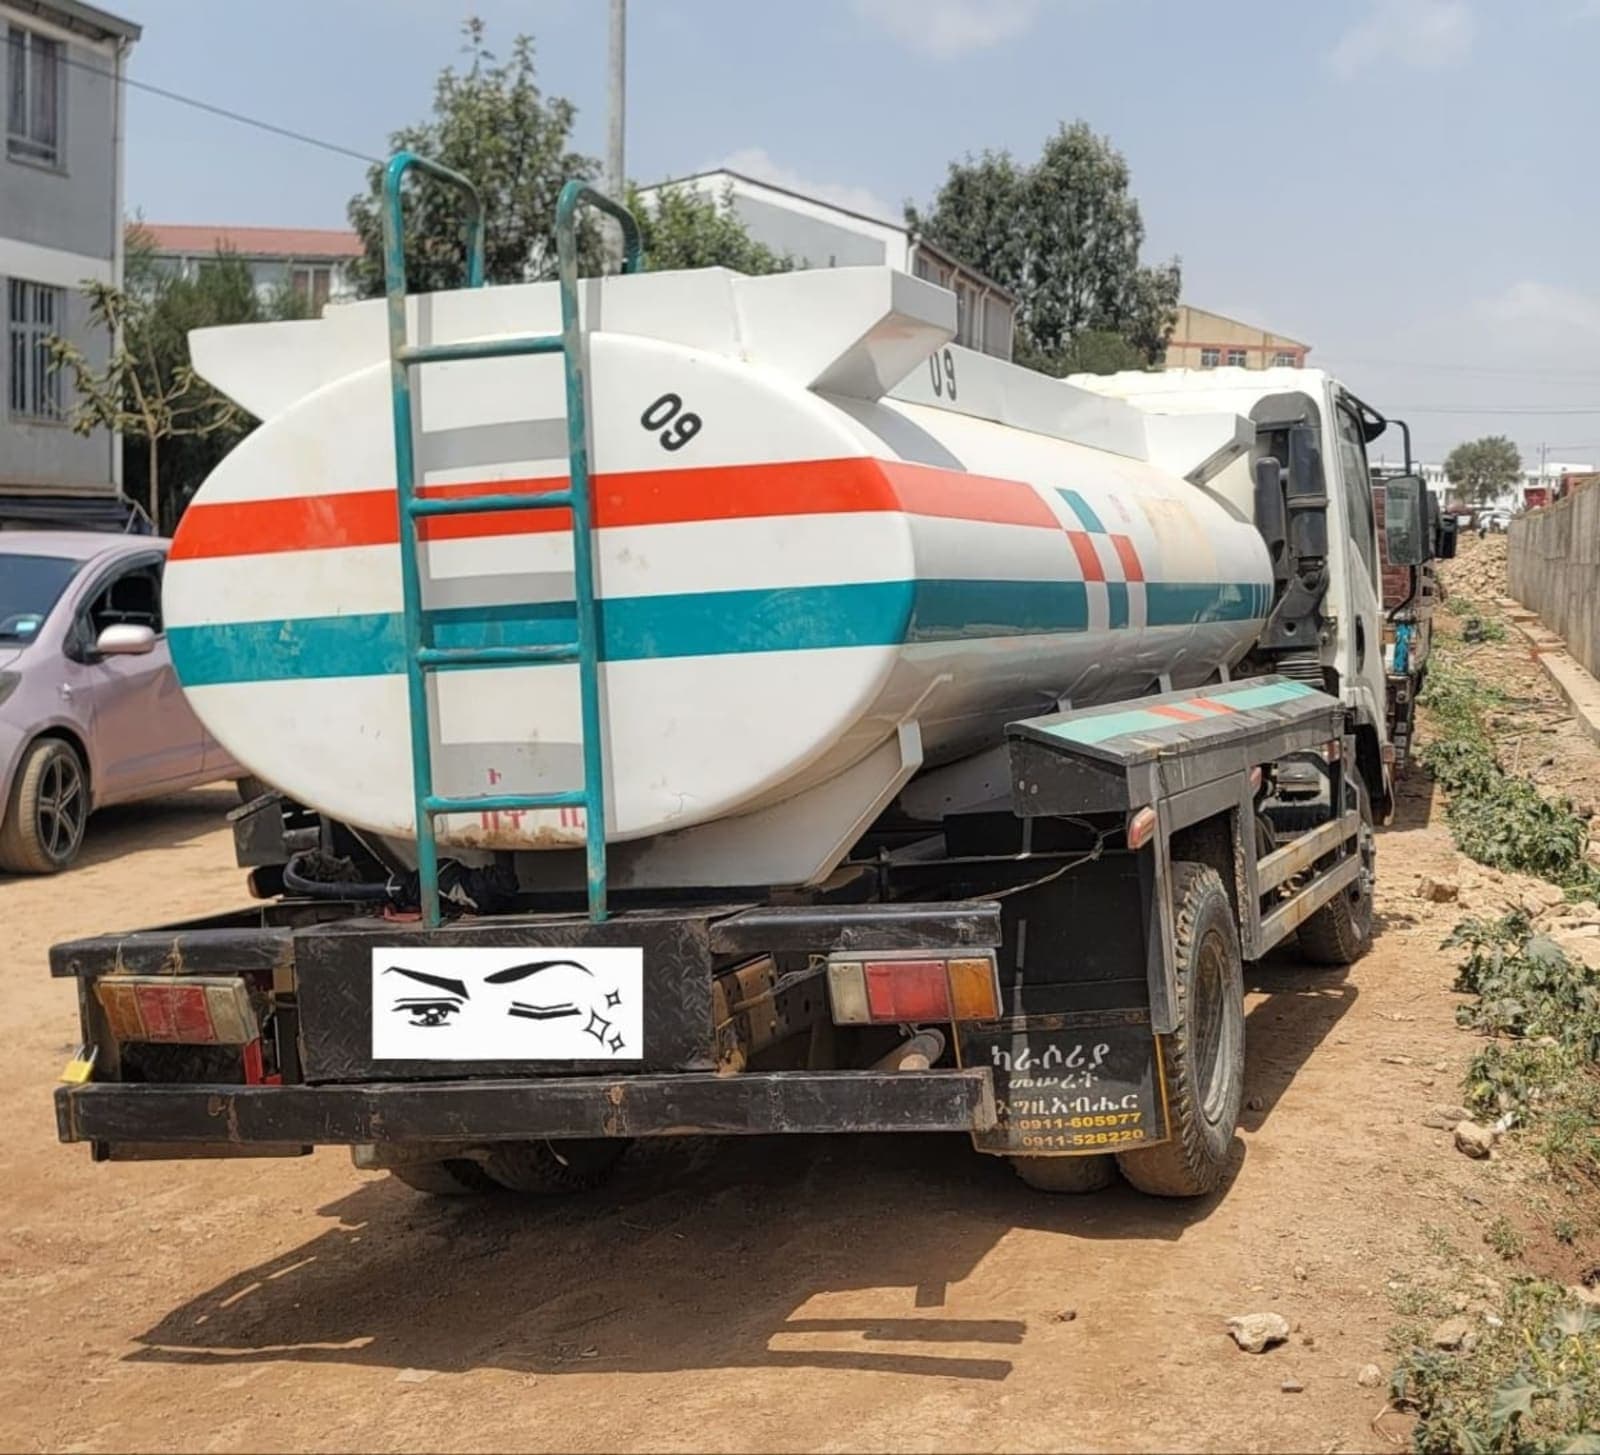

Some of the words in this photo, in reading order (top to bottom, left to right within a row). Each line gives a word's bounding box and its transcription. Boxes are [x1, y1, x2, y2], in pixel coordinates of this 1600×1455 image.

[929, 348, 958, 401] 09
[640, 392, 703, 452] 09
[1019, 1112, 1142, 1131] 0911-605977
[1022, 1129, 1144, 1147] 0911-528220
